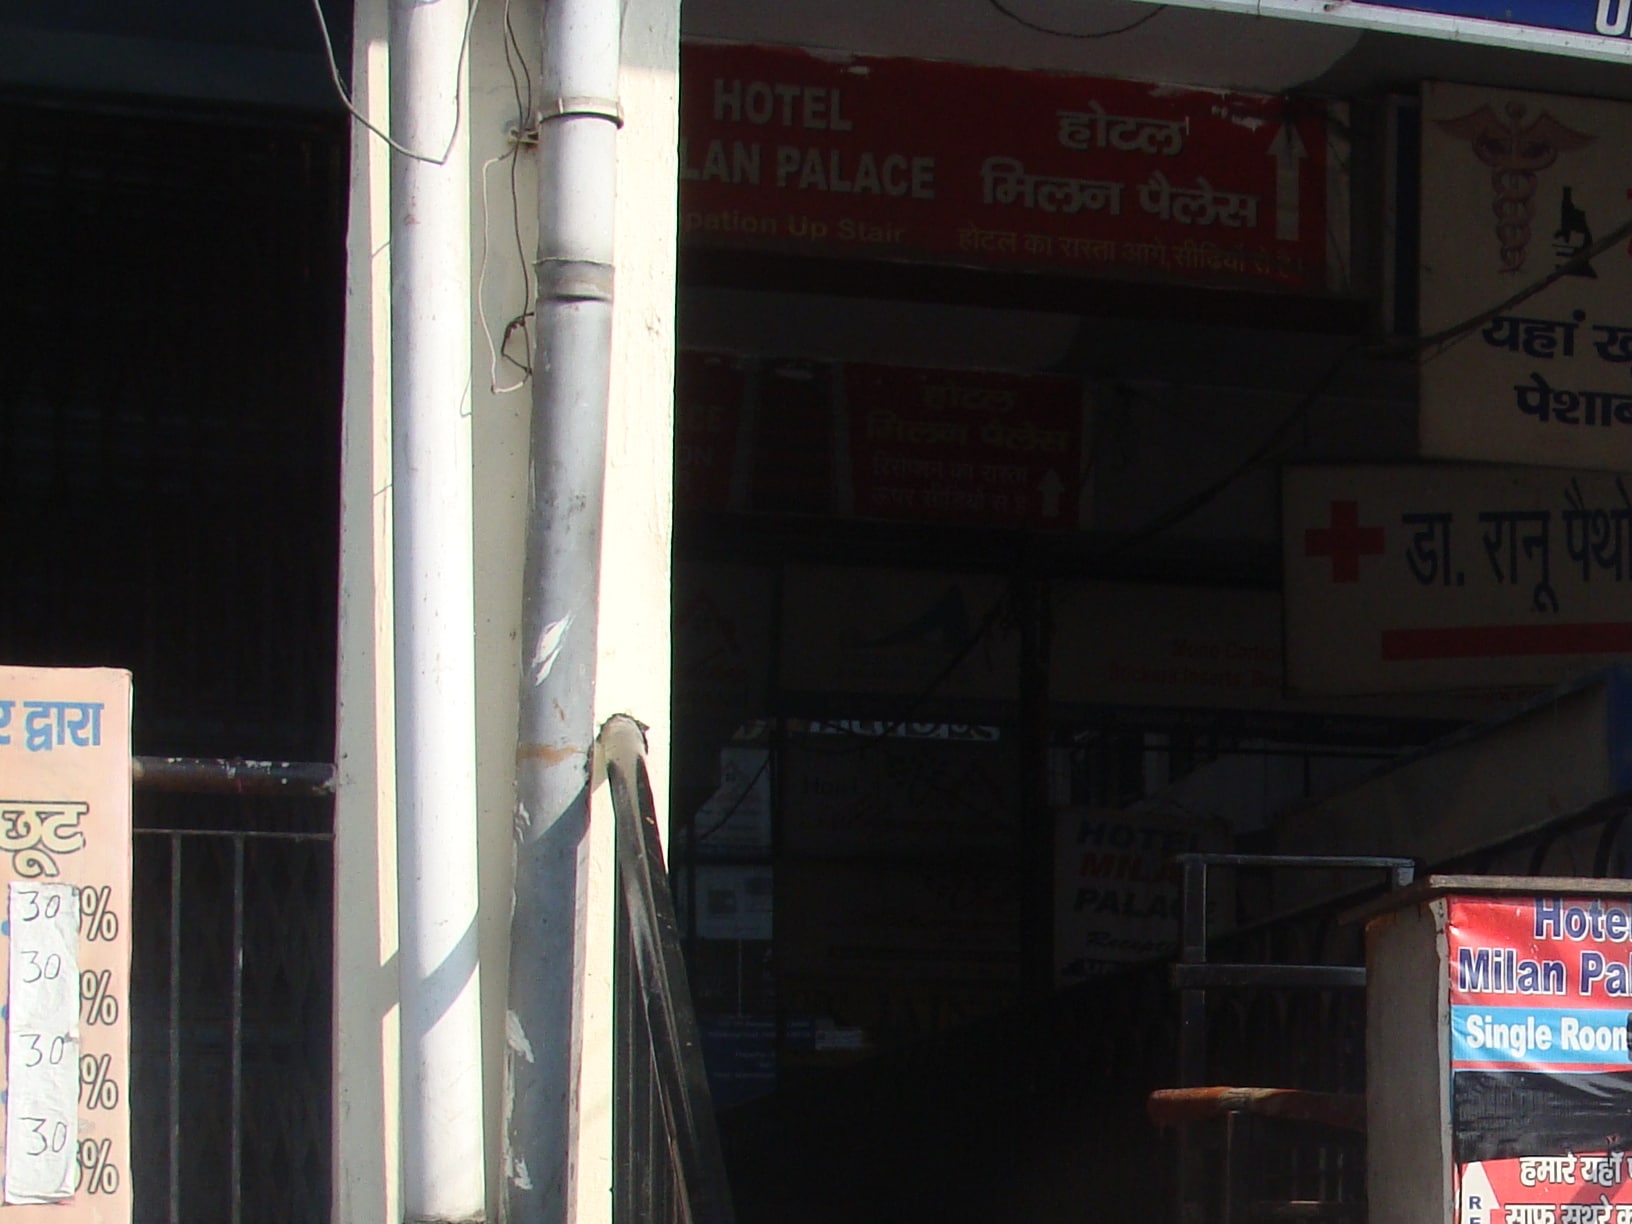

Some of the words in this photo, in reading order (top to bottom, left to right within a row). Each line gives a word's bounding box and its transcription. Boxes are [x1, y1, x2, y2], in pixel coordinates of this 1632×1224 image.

[713, 78, 853, 132] HOTEL
[1055, 100, 1188, 157] होटल
[679, 135, 762, 186] LAN
[775, 144, 937, 200] PALACE
[979, 155, 1125, 216] मिलन
[1137, 169, 1262, 229] पैलेस
[1482, 309, 1587, 358] यहां
[23, 700, 104, 751] द्वारा
[0, 800, 89, 878] छूट
[17, 891, 61, 921] 30
[20, 951, 60, 983] 30
[1458, 946, 1567, 996] Milan
[20, 1034, 64, 1067] 30
[1466, 1014, 1553, 1058] Single
[19, 1117, 67, 1156] 30
[1519, 1152, 1577, 1186] हमारे
